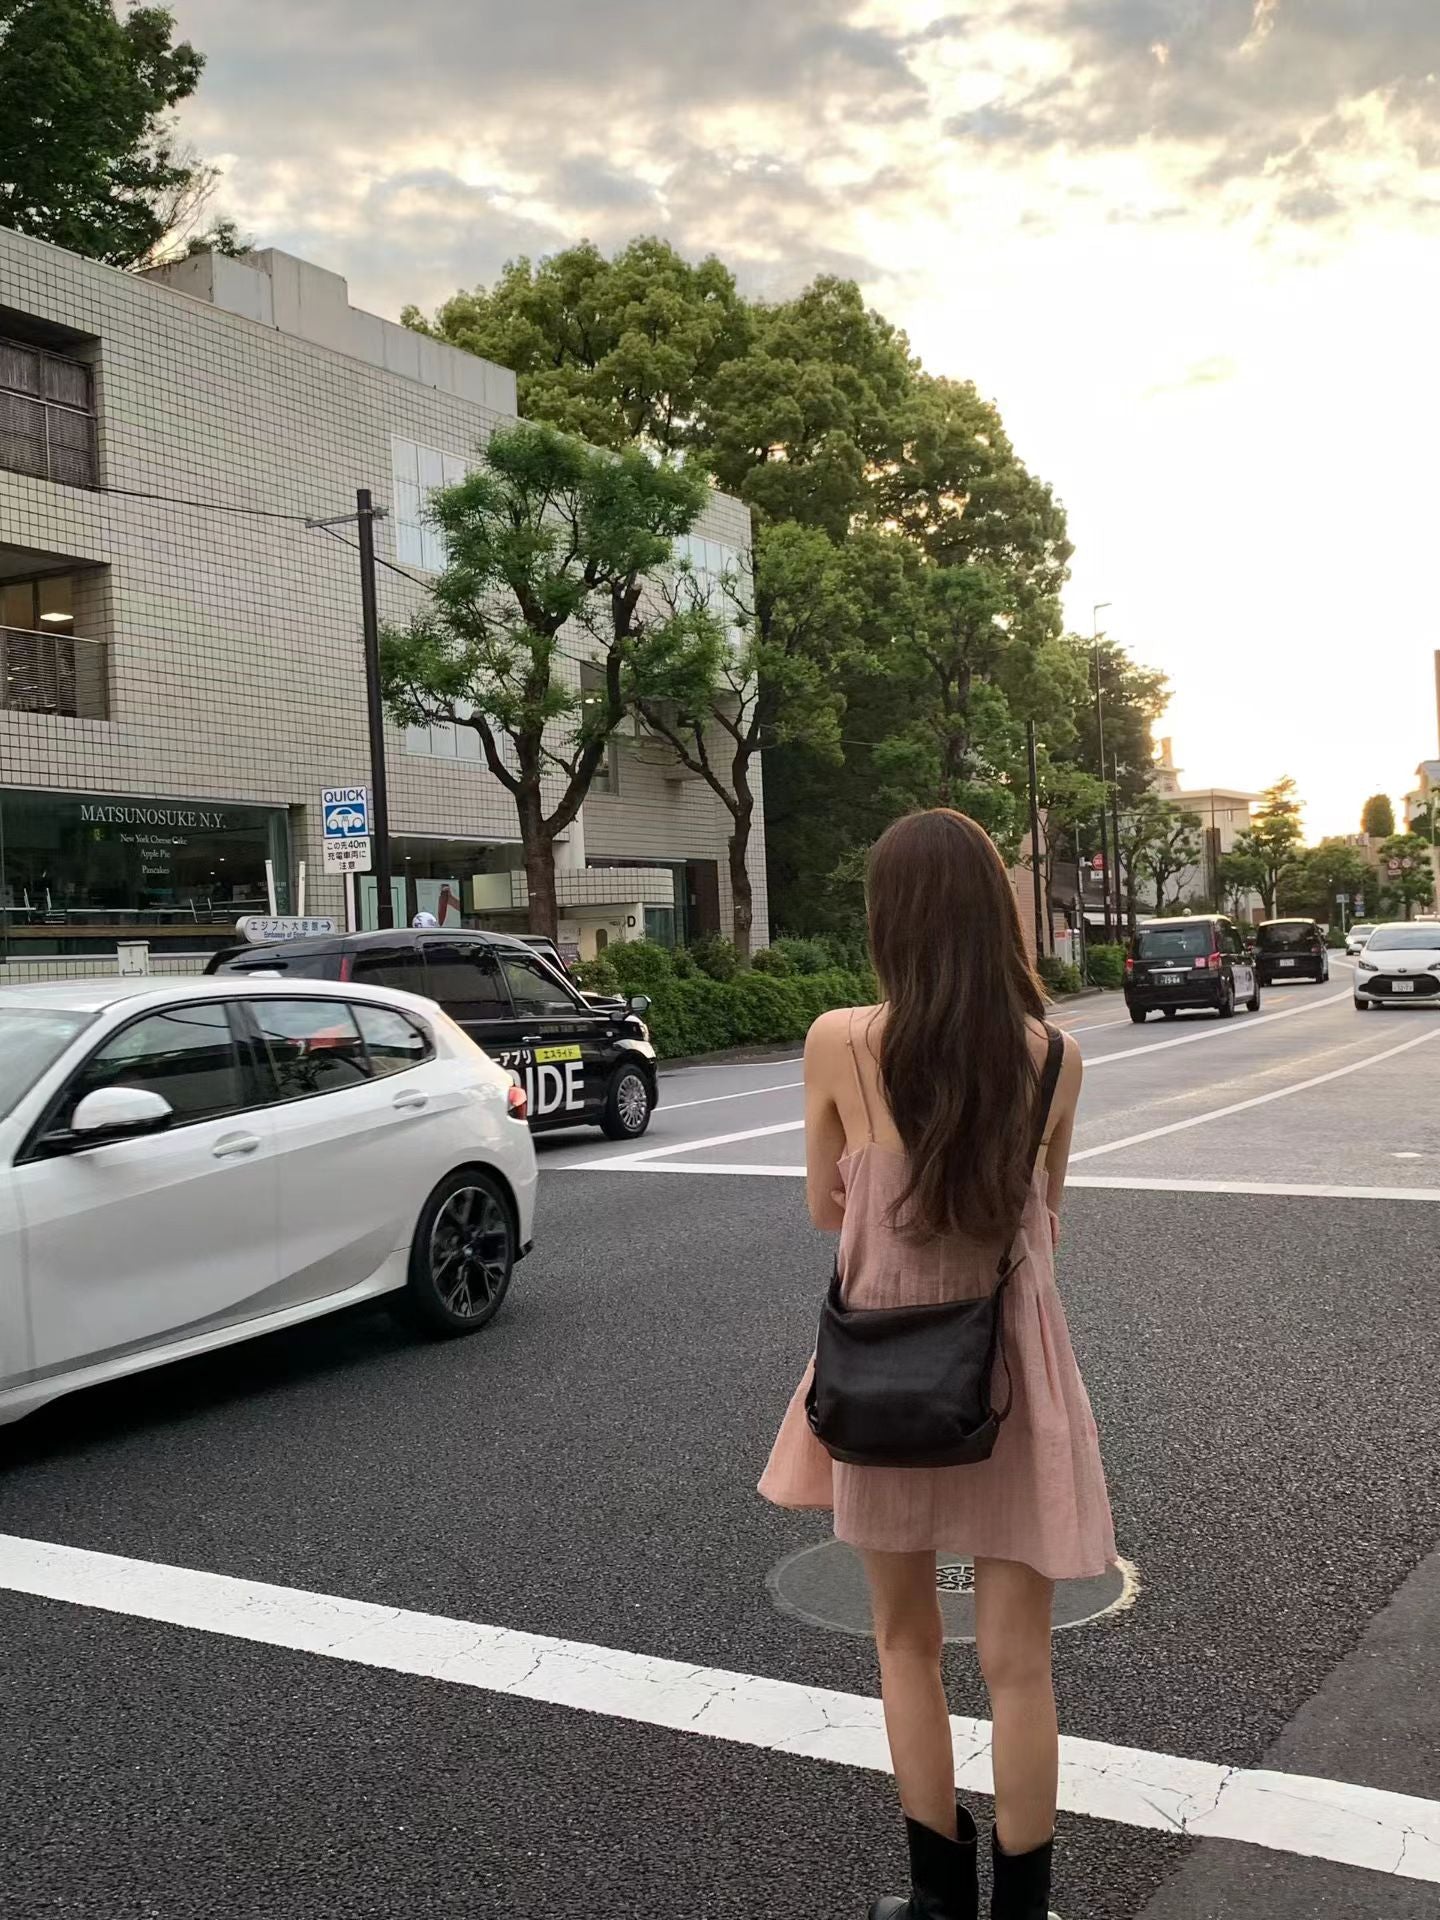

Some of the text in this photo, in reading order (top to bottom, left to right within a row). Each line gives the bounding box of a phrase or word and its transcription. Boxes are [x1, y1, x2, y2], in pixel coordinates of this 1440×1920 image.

[323, 788, 365, 803] QUICK
[80, 804, 227, 828] MATSUNOSUKE N.Y.
[120, 833, 135, 843] New
[135, 834, 149, 844] York
[326, 839, 367, 850] この先40m
[140, 848, 171, 861] Apple Pie
[327, 850, 367, 861] 充電車両に
[141, 865, 170, 874] Pancakes
[339, 861, 356, 870] 注意
[250, 920, 319, 931] エジプト大使館
[627, 915, 636, 928] D
[543, 1048, 574, 1059] エスライド
